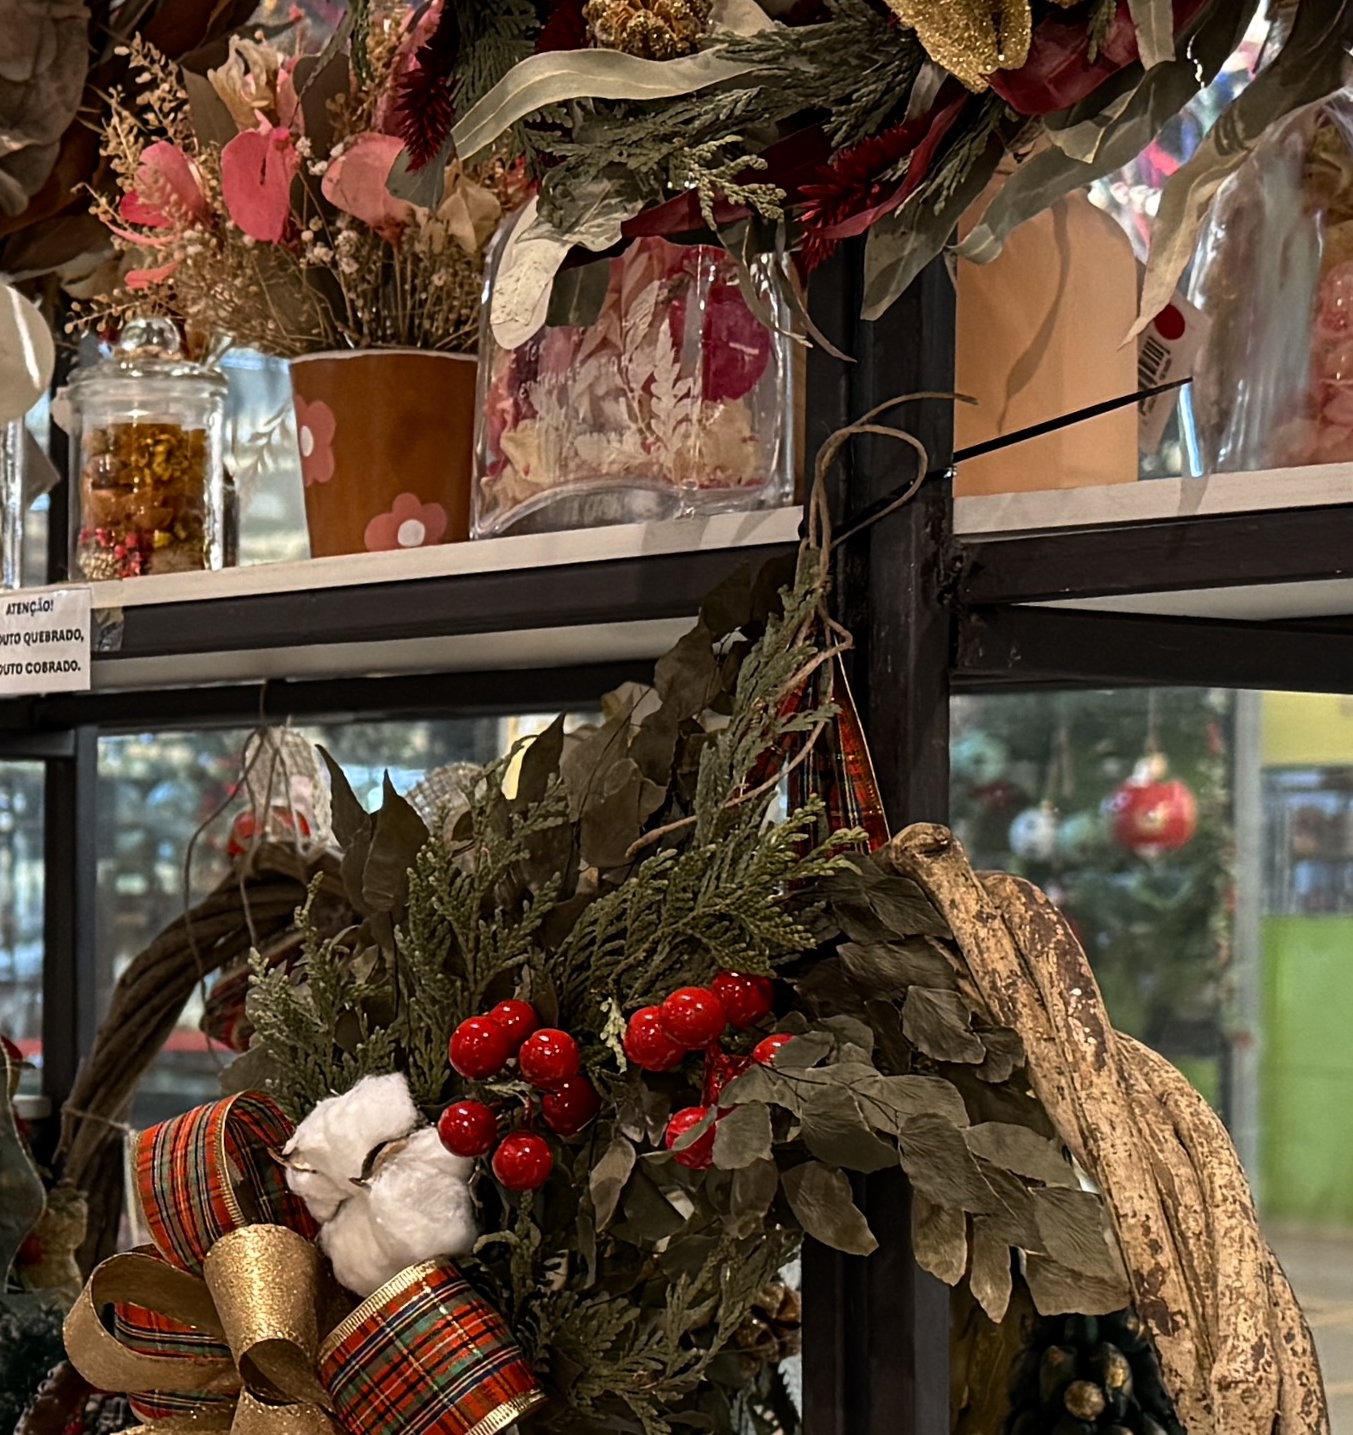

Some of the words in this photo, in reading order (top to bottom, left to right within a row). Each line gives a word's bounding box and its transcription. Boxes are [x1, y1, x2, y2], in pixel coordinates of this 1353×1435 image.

[6, 597, 54, 617] ATENÇÃO!
[23, 628, 84, 647] QUEBRADO,
[25, 660, 81, 675] COBRADO.
